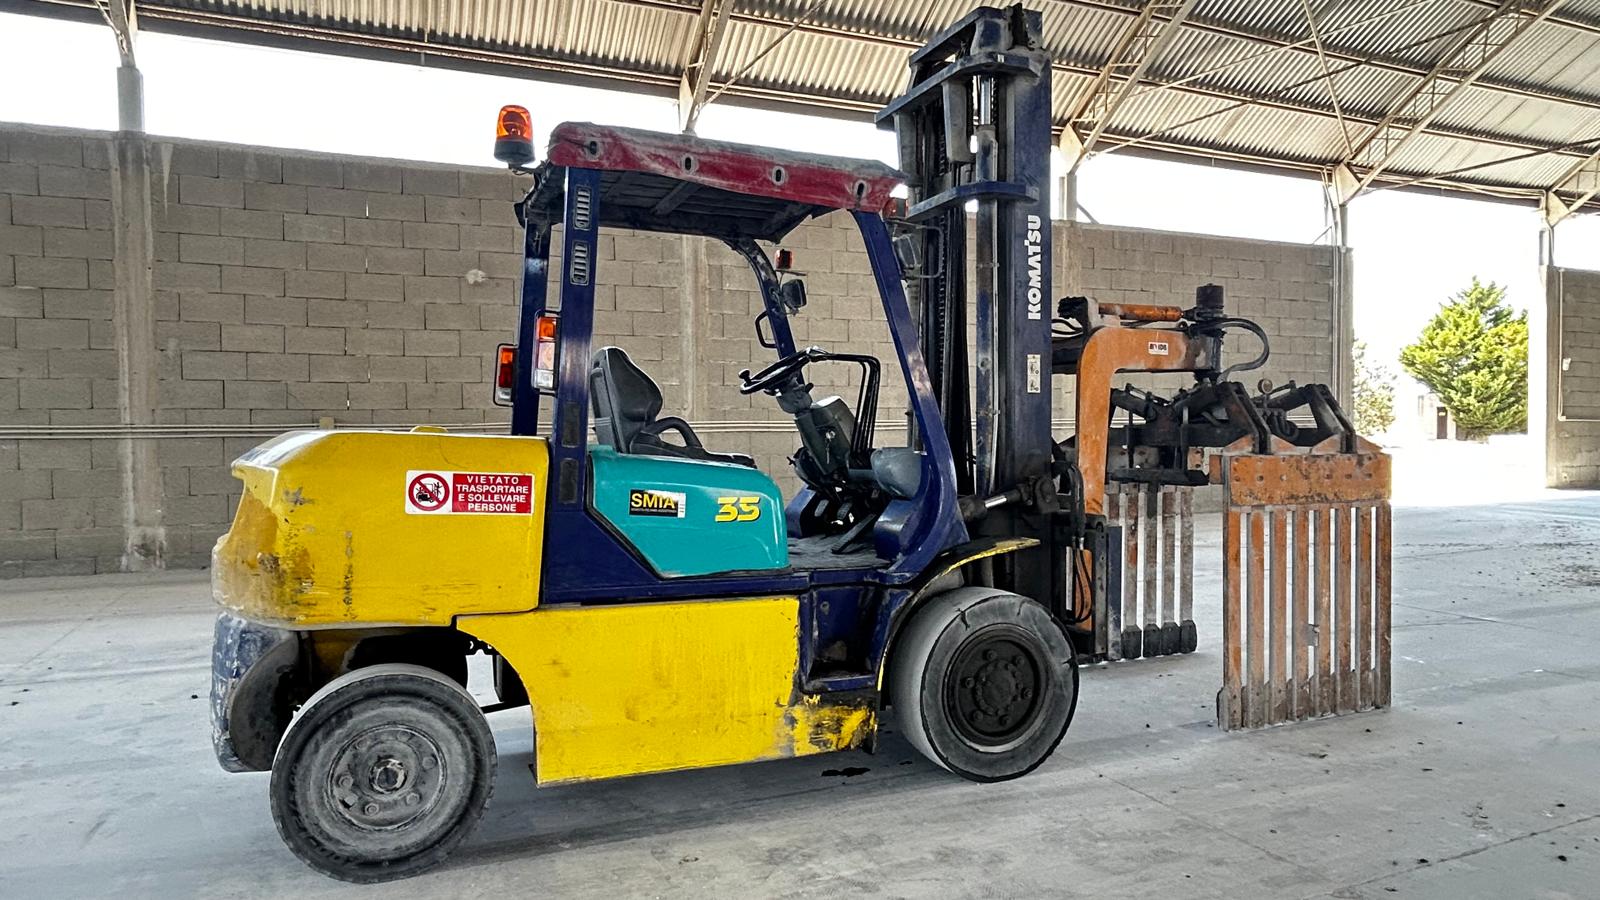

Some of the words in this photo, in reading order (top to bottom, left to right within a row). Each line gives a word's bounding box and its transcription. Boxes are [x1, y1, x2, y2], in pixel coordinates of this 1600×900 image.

[1024, 214, 1041, 320] KOMATSU
[466, 475, 519, 485] VIETATO
[456, 484, 529, 494] TRASPORTARE
[458, 493, 465, 502] E
[467, 493, 526, 503] SOLLEVARE
[631, 492, 676, 509] SMIA
[467, 503, 517, 512] PERSONE
[715, 496, 760, 522] 35
